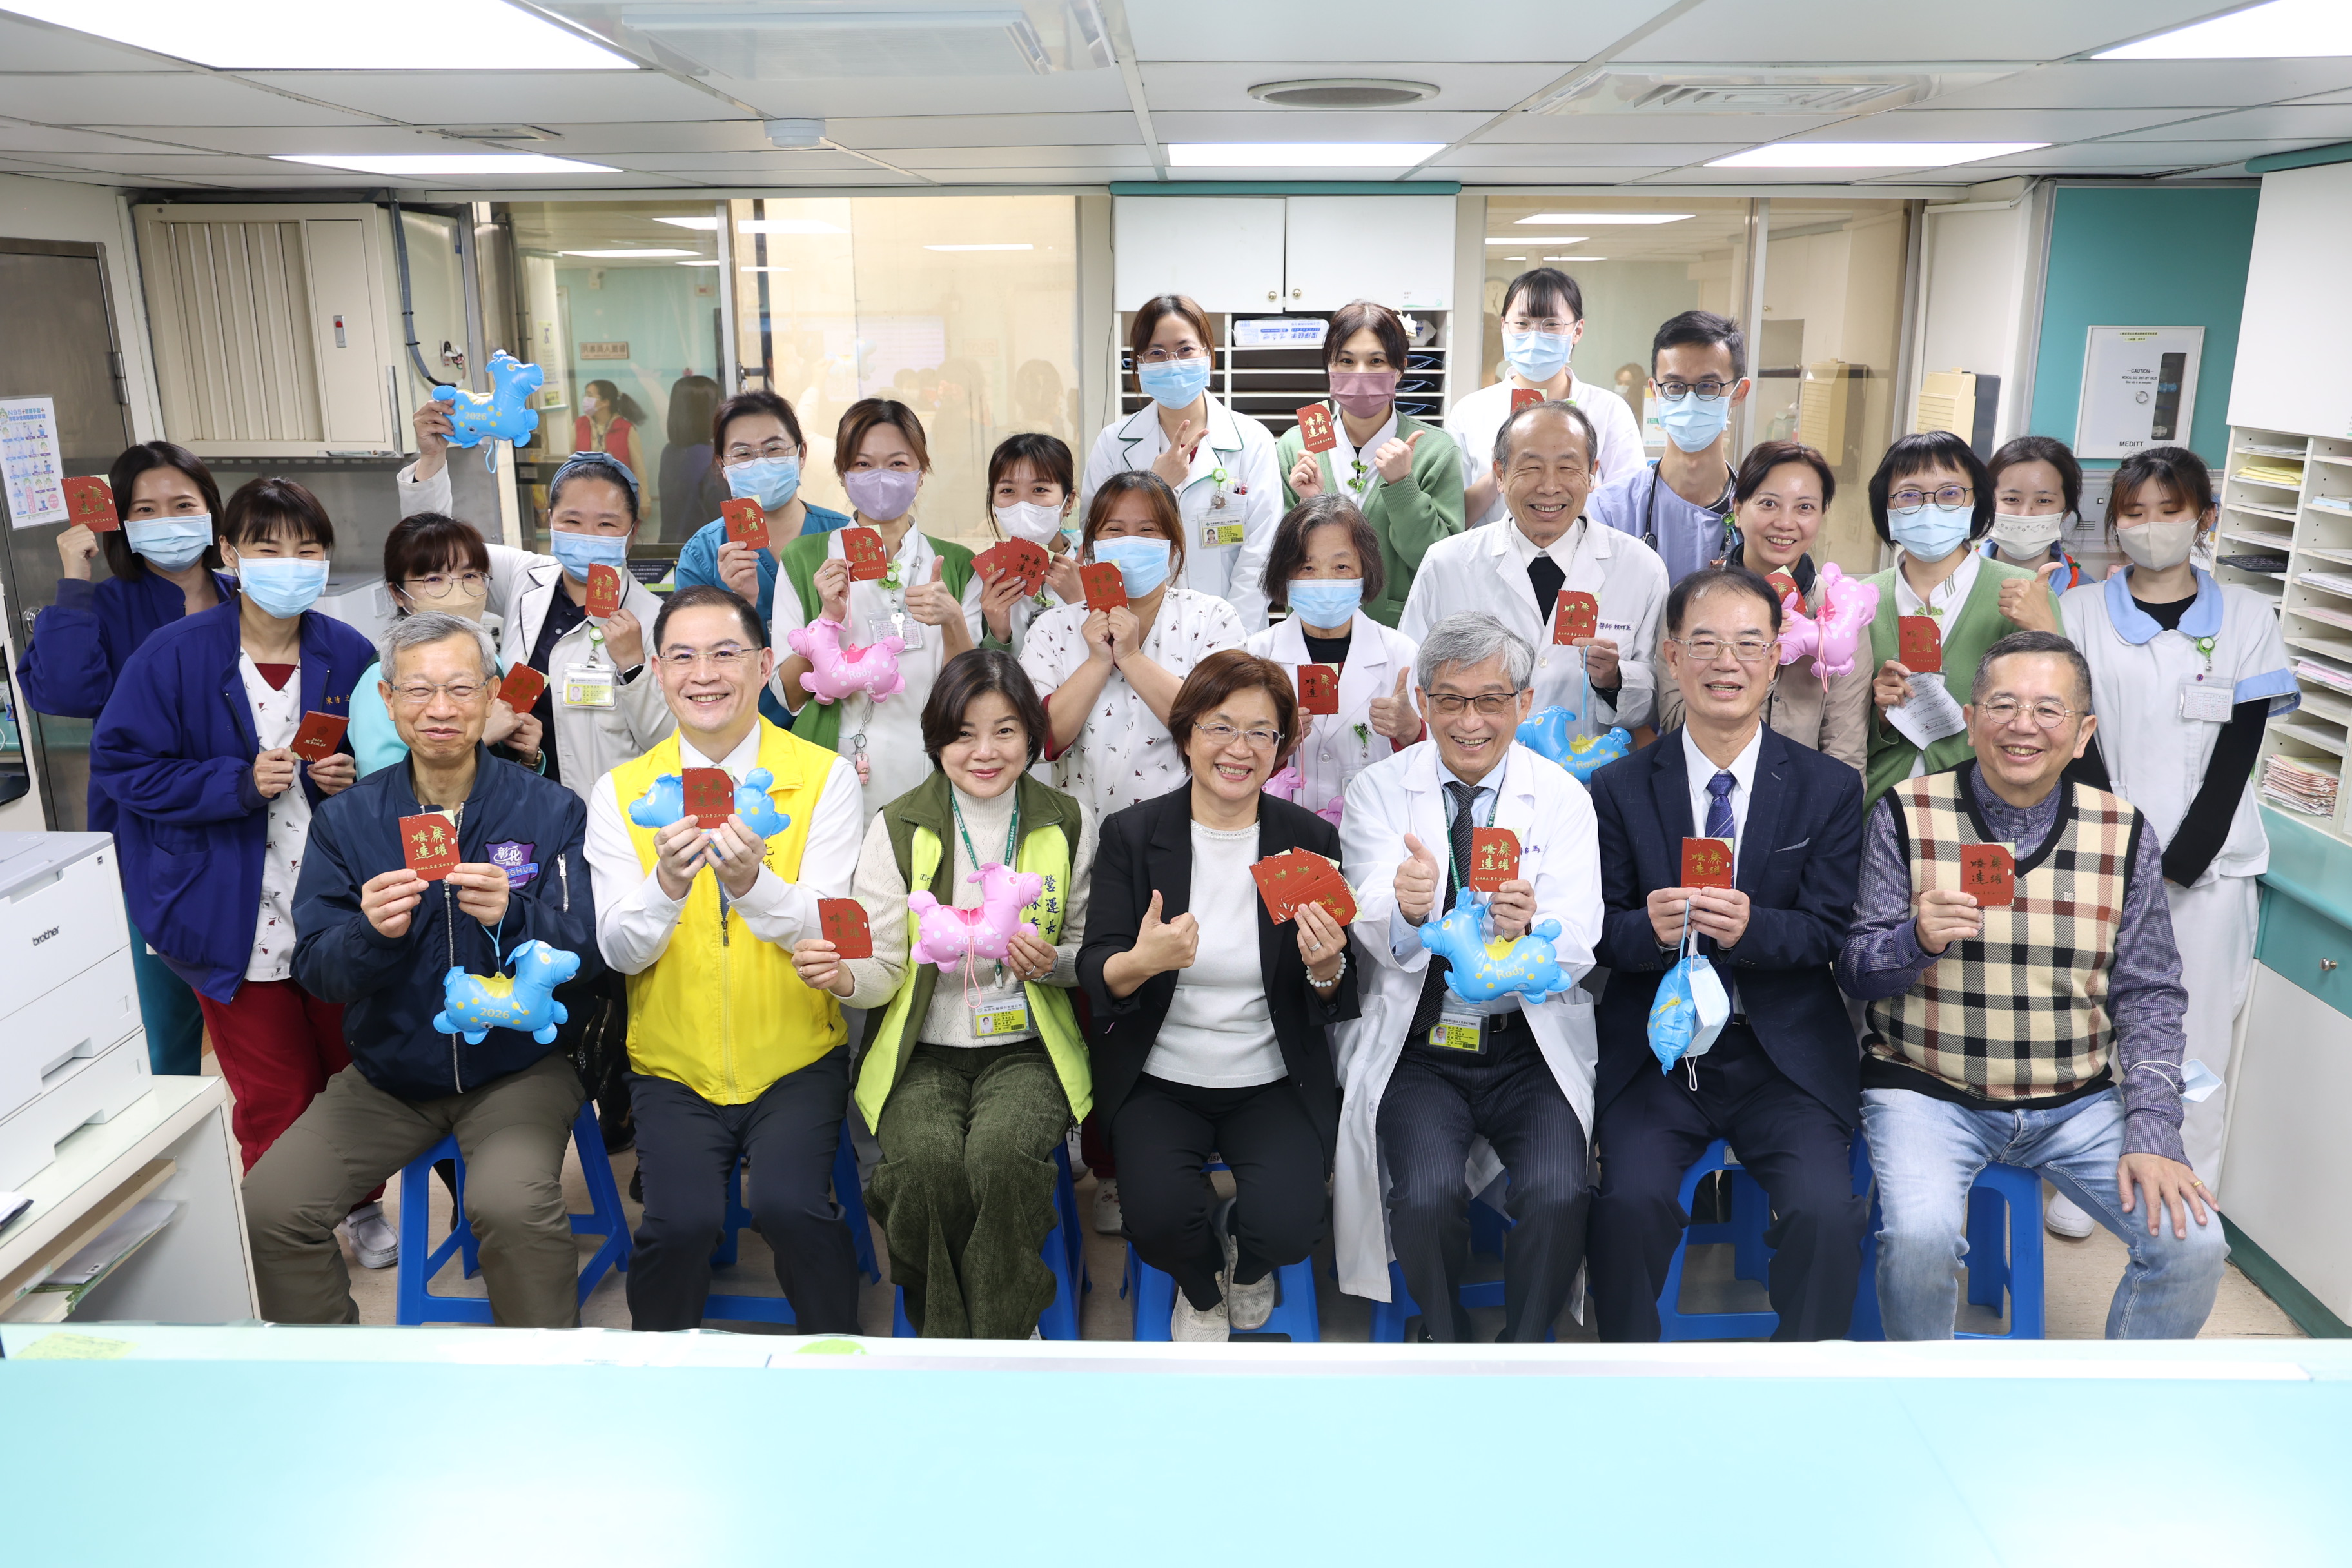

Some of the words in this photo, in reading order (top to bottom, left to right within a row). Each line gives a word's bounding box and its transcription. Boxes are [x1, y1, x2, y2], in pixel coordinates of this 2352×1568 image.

[465, 411, 487, 420] 2026
[848, 669, 872, 680] Rody
[1576, 758, 1601, 769] Rody
[498, 847, 520, 861] 彰化
[1533, 845, 1540, 854] 馬
[1044, 875, 1060, 934] 營運長
[32, 925, 60, 947] brother
[1496, 965, 1524, 980] Rody
[480, 1008, 510, 1019] 2026
